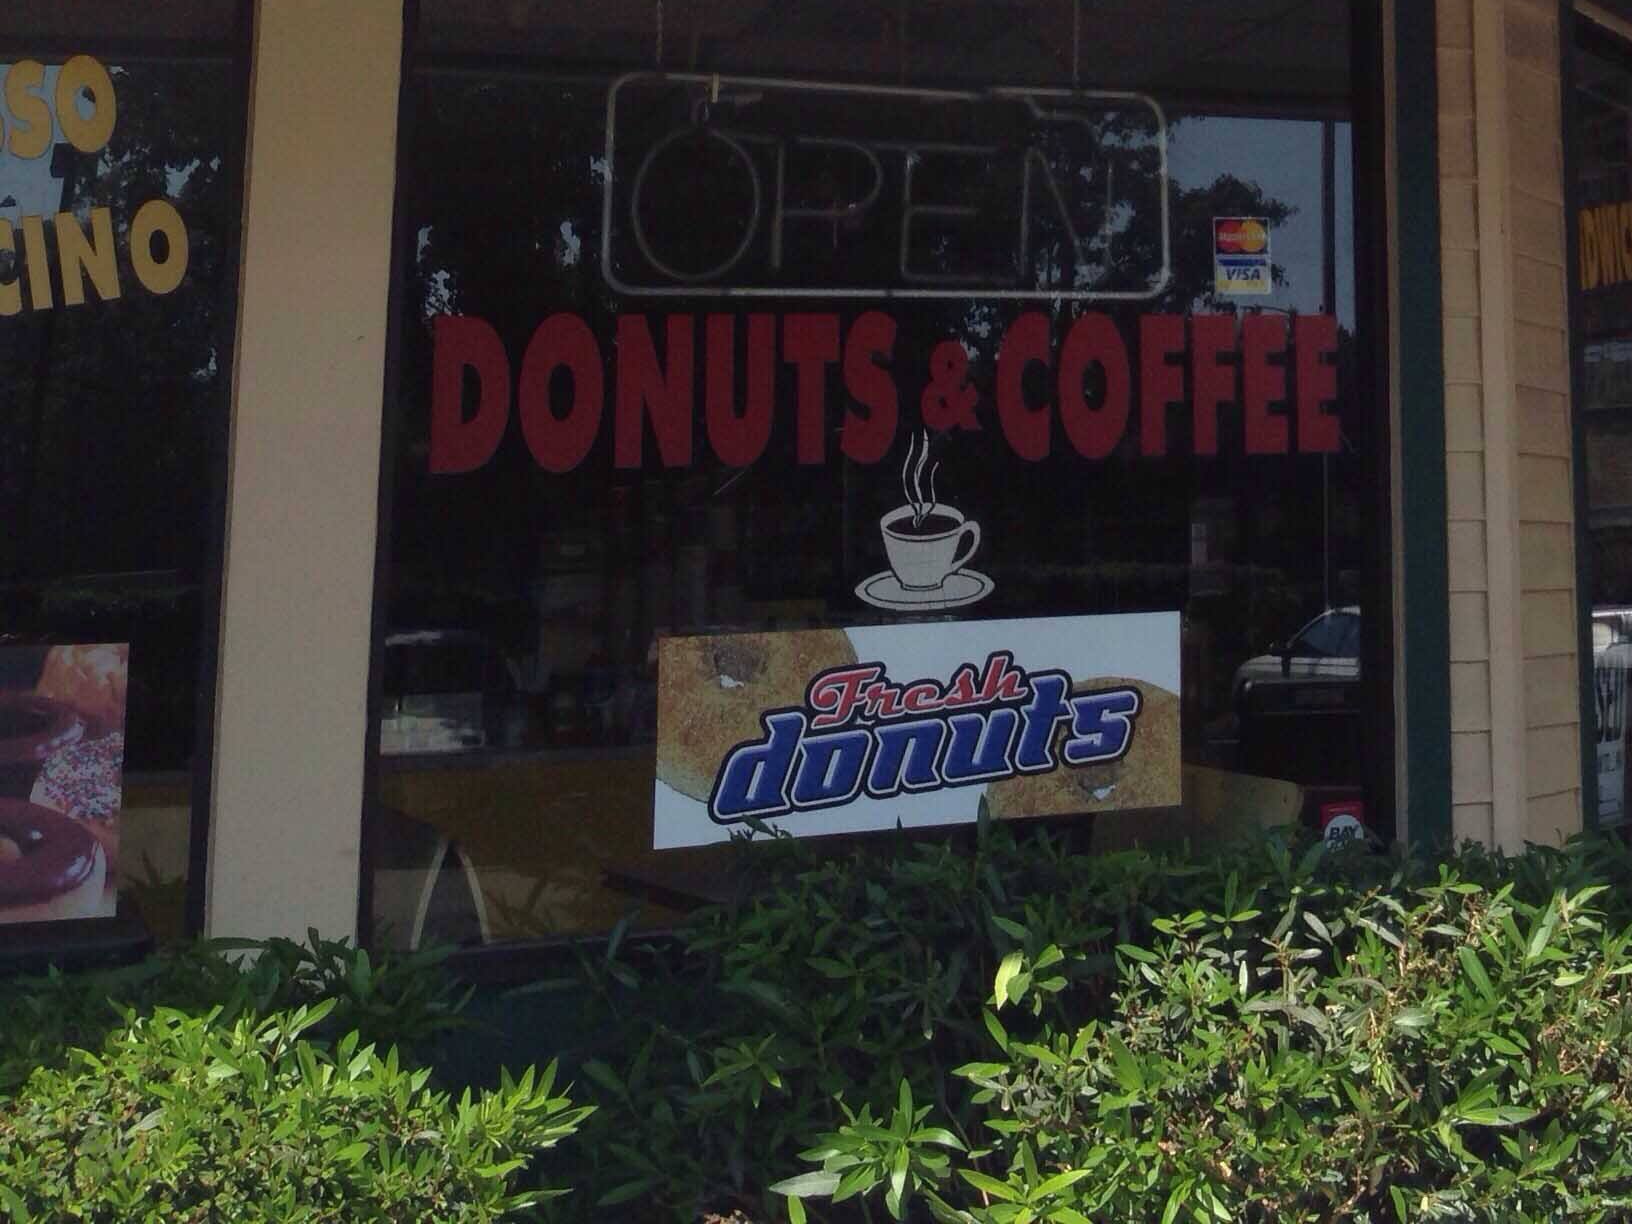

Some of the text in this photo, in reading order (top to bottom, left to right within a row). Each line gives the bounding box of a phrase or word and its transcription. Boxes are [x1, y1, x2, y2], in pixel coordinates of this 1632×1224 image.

[0, 54, 118, 160] SO
[631, 126, 1115, 281] OPEN
[1225, 267, 1261, 281] VISA
[429, 310, 1342, 474] DONUTS & COFFEE
[714, 676, 1139, 820] donuts
[808, 654, 1030, 728] Fresh
